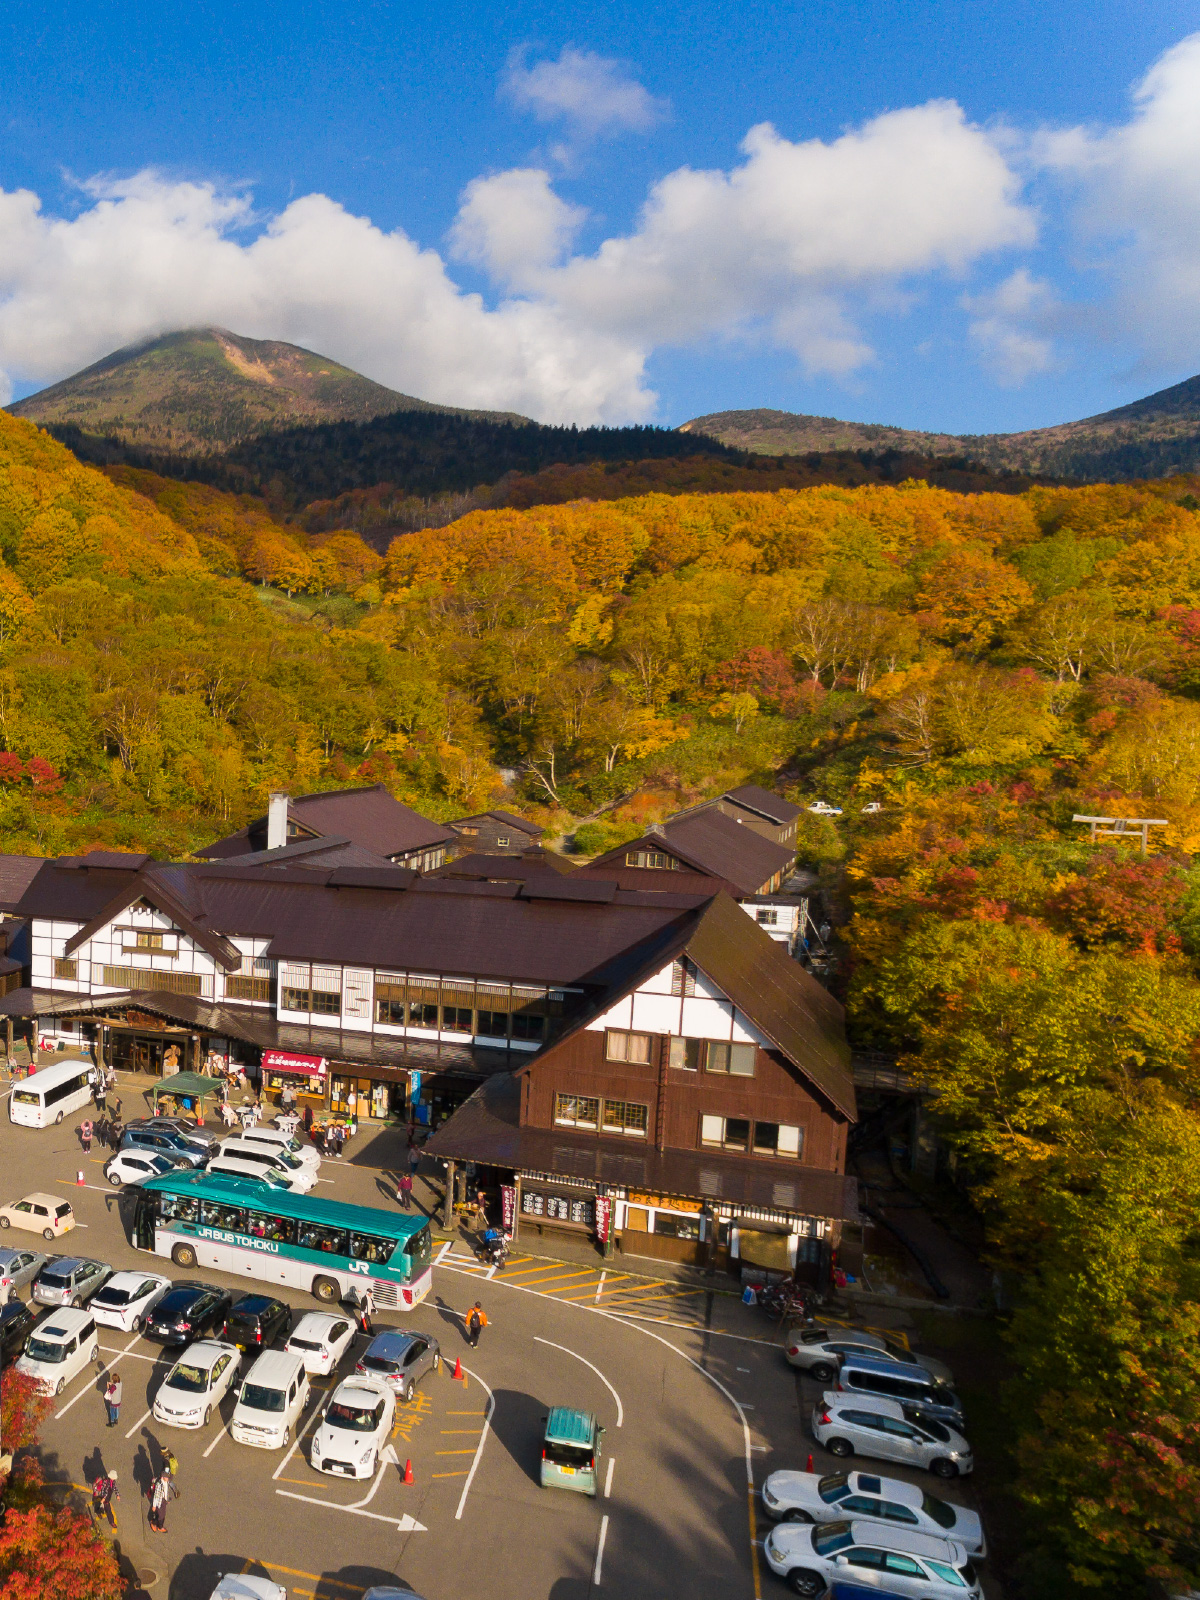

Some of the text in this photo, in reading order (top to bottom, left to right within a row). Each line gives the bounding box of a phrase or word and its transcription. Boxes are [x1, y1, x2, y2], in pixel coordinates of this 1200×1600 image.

[198, 1228, 279, 1253] JR BUS TOHOKU
[348, 1261, 370, 1275] JR
